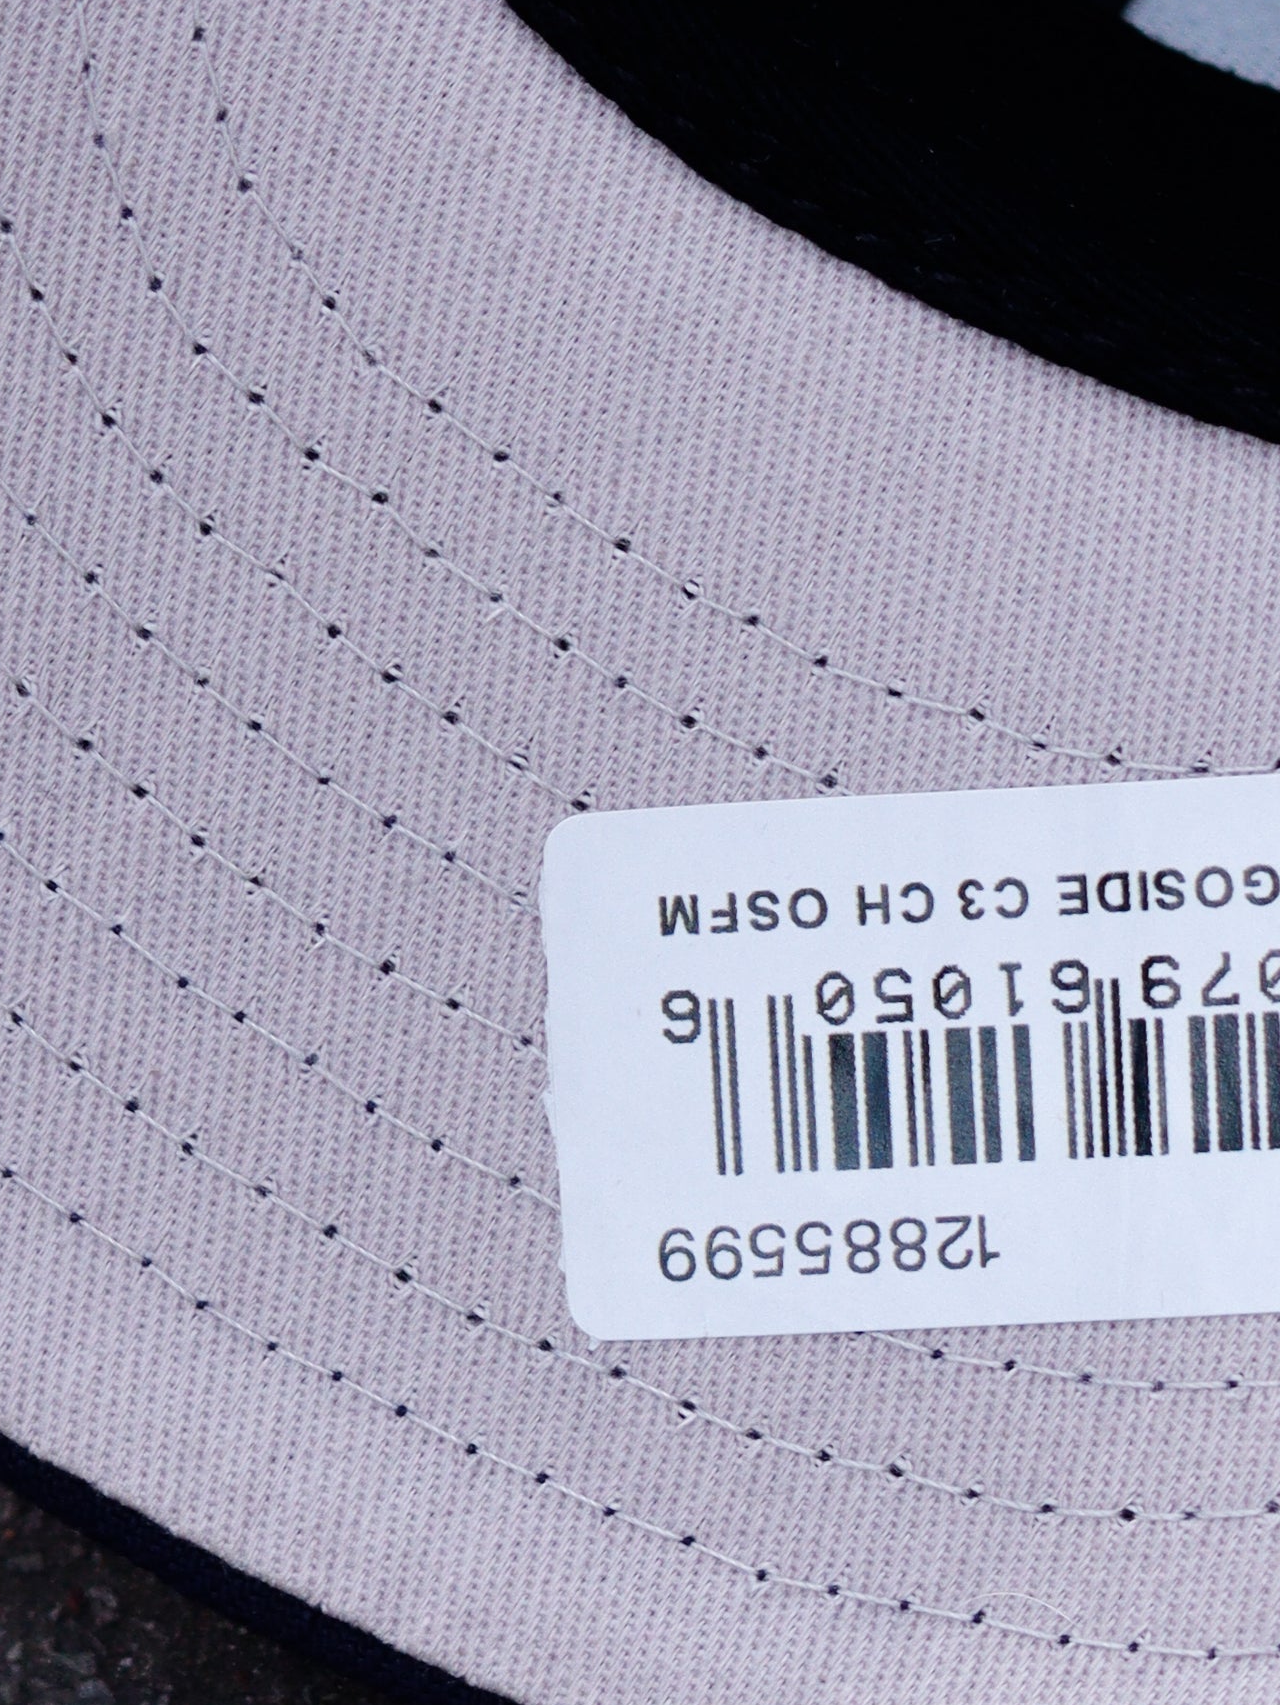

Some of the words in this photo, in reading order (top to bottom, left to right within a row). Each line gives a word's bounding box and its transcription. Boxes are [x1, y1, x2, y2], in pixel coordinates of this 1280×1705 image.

[658, 887, 828, 937] OSFM
[858, 881, 935, 926] CH
[960, 876, 1029, 920] C3
[662, 989, 702, 1045] 6
[815, 957, 1092, 1026] 61050
[658, 1213, 1001, 1284] 12885599
